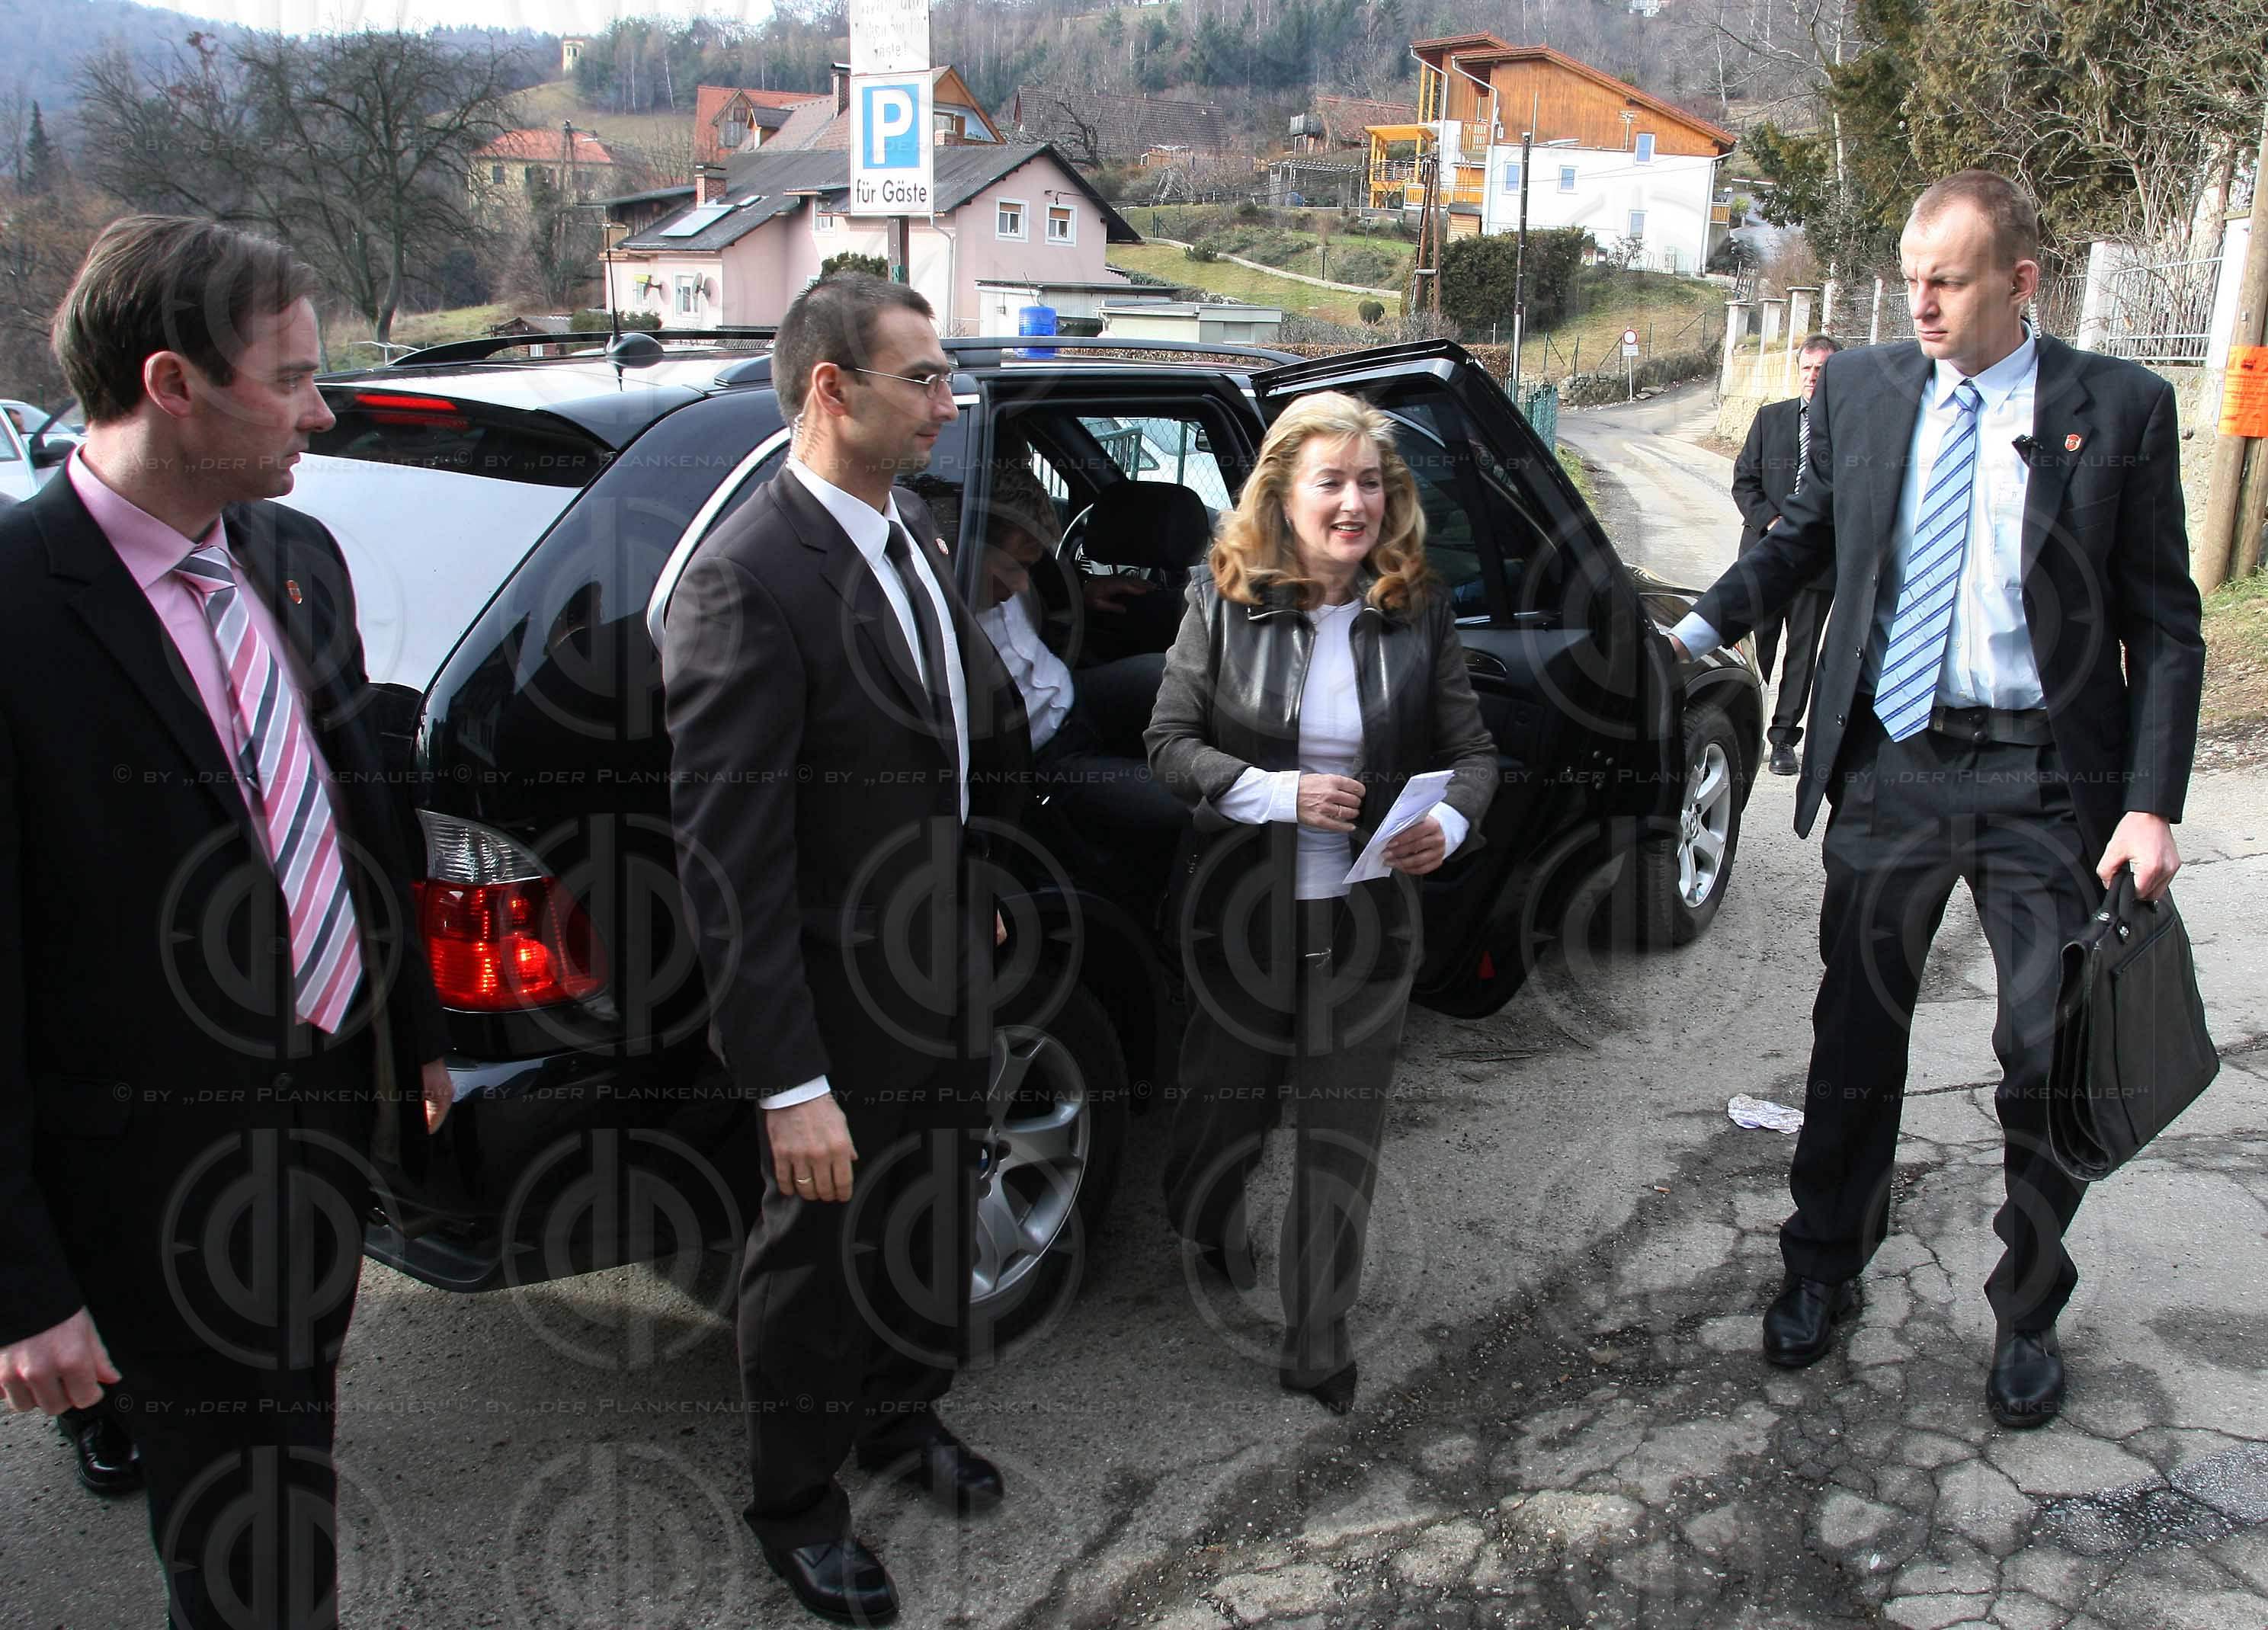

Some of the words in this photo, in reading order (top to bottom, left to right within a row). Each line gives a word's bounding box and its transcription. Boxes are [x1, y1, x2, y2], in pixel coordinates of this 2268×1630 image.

[872, 89, 913, 164] P
[857, 179, 876, 203] für
[883, 180, 927, 203] Gäste
